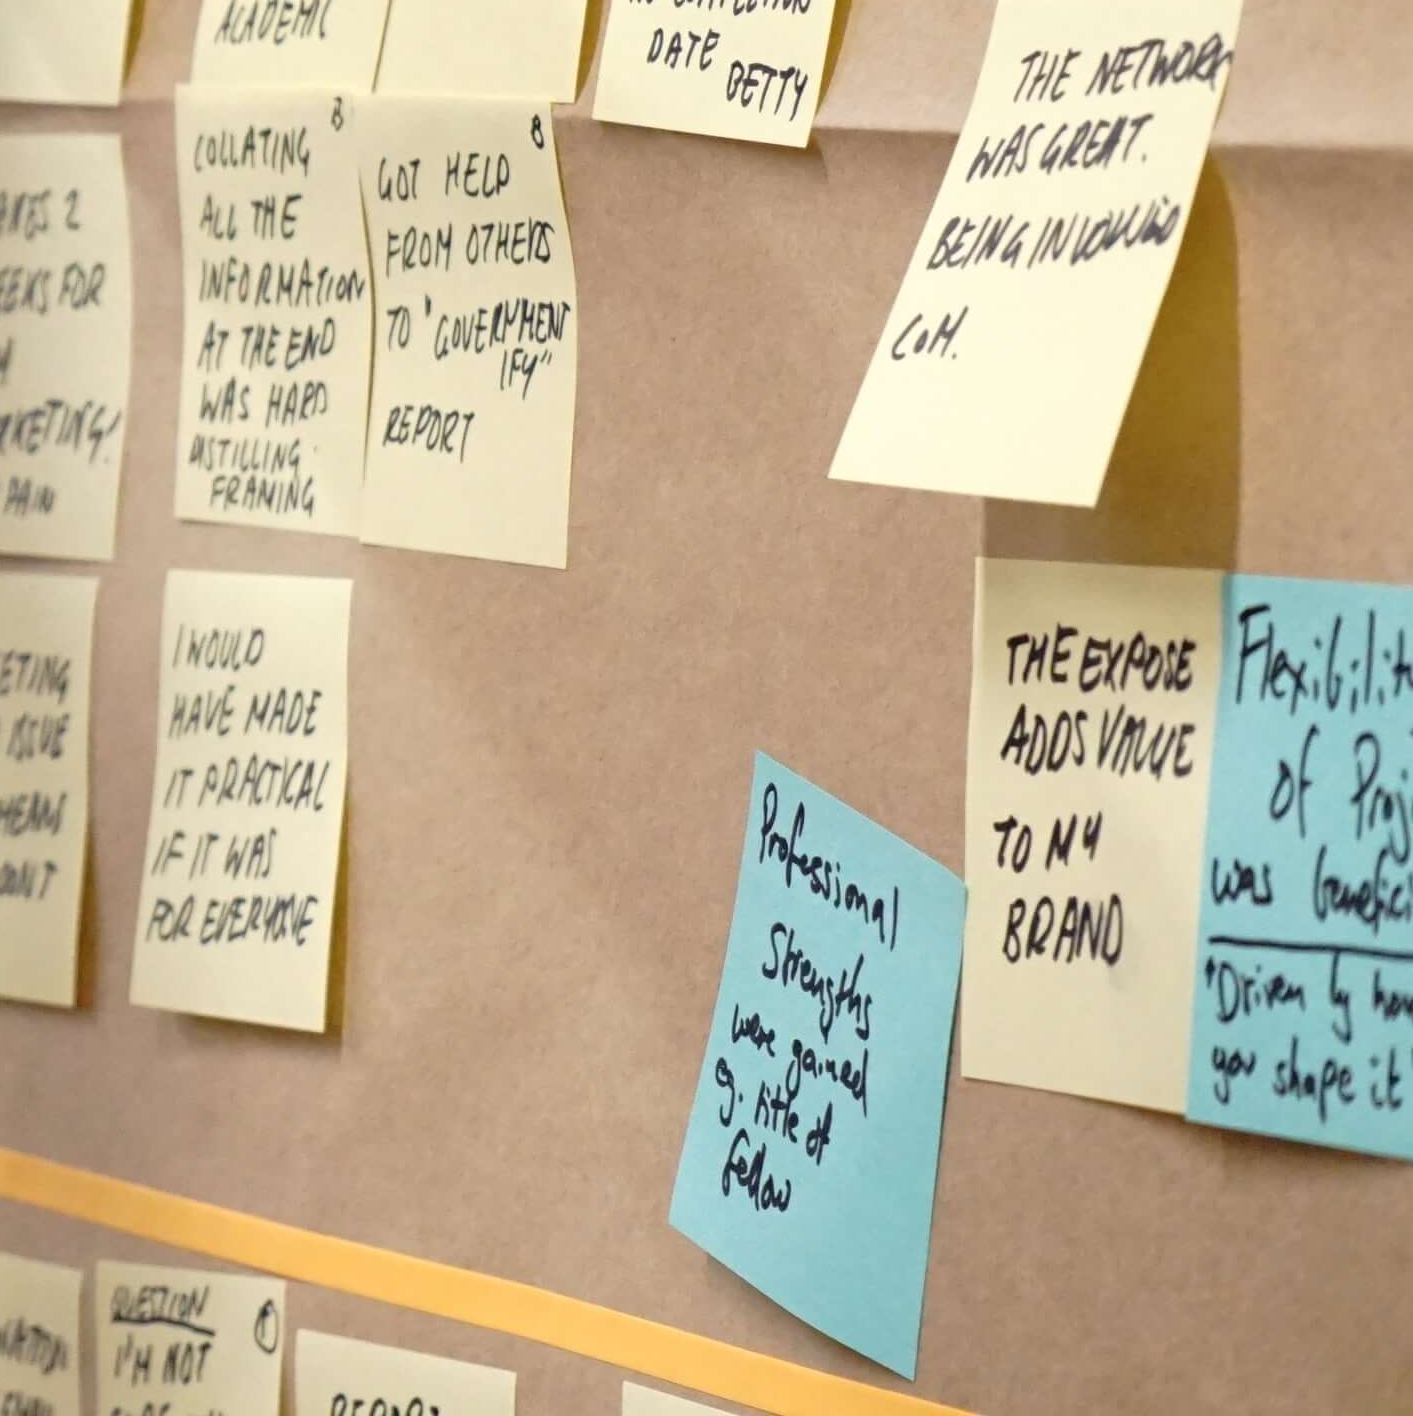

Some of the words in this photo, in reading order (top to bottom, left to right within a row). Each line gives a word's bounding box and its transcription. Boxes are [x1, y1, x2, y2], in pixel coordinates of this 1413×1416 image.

[647, 28, 720, 71] DATE
[1013, 50, 1082, 103] THE
[1085, 32, 1235, 96] NETWORK
[194, 125, 312, 178] COLLATING
[378, 157, 420, 202] GOT
[445, 152, 510, 198] HELP
[966, 123, 1044, 183] WAS
[65, 189, 82, 231] 2
[199, 194, 238, 241] ALL
[251, 194, 303, 239] THE
[386, 221, 452, 277] FROM
[465, 216, 555, 266] OTHERS
[926, 214, 1030, 271] BEING
[58, 262, 106, 310] FOR
[199, 255, 365, 309] INFORMATION
[197, 319, 229, 373] AT
[241, 322, 280, 368] THE
[284, 317, 335, 371] END
[386, 306, 412, 350] TO
[199, 377, 250, 425] WAS
[265, 382, 328, 429] HARD
[382, 405, 475, 464] REPORT
[3, 475, 56, 518] PAIN
[209, 475, 316, 519] FRAMING
[172, 623, 185, 670] I
[187, 626, 267, 671] WOULD
[1006, 622, 1080, 687] THE
[1078, 632, 1197, 693] EXPOSE
[6, 712, 70, 762] ISSUE
[169, 683, 236, 740] HAVE
[244, 686, 323, 739] MADE
[1000, 703, 1088, 775] ADDS
[1096, 704, 1196, 780] VALUE
[164, 768, 194, 810] IT
[198, 752, 331, 814] PRACTICAL
[1269, 723, 1320, 838] of
[151, 830, 187, 879] IF
[189, 833, 219, 879] IT
[223, 827, 278, 880] WAS
[759, 782, 899, 952] Professional
[993, 814, 1031, 873] TO
[1045, 810, 1102, 869] MY
[1211, 856, 1275, 907] was
[145, 897, 196, 945] FOR
[200, 893, 320, 948] EVERYONE
[1002, 893, 1124, 966] BRAND
[762, 921, 873, 1046] Strengths
[1275, 1036, 1357, 1123] shape
[805, 1101, 833, 1166] of
[110, 1284, 210, 1322] QUESTION
[163, 1341, 211, 1386] NOT
